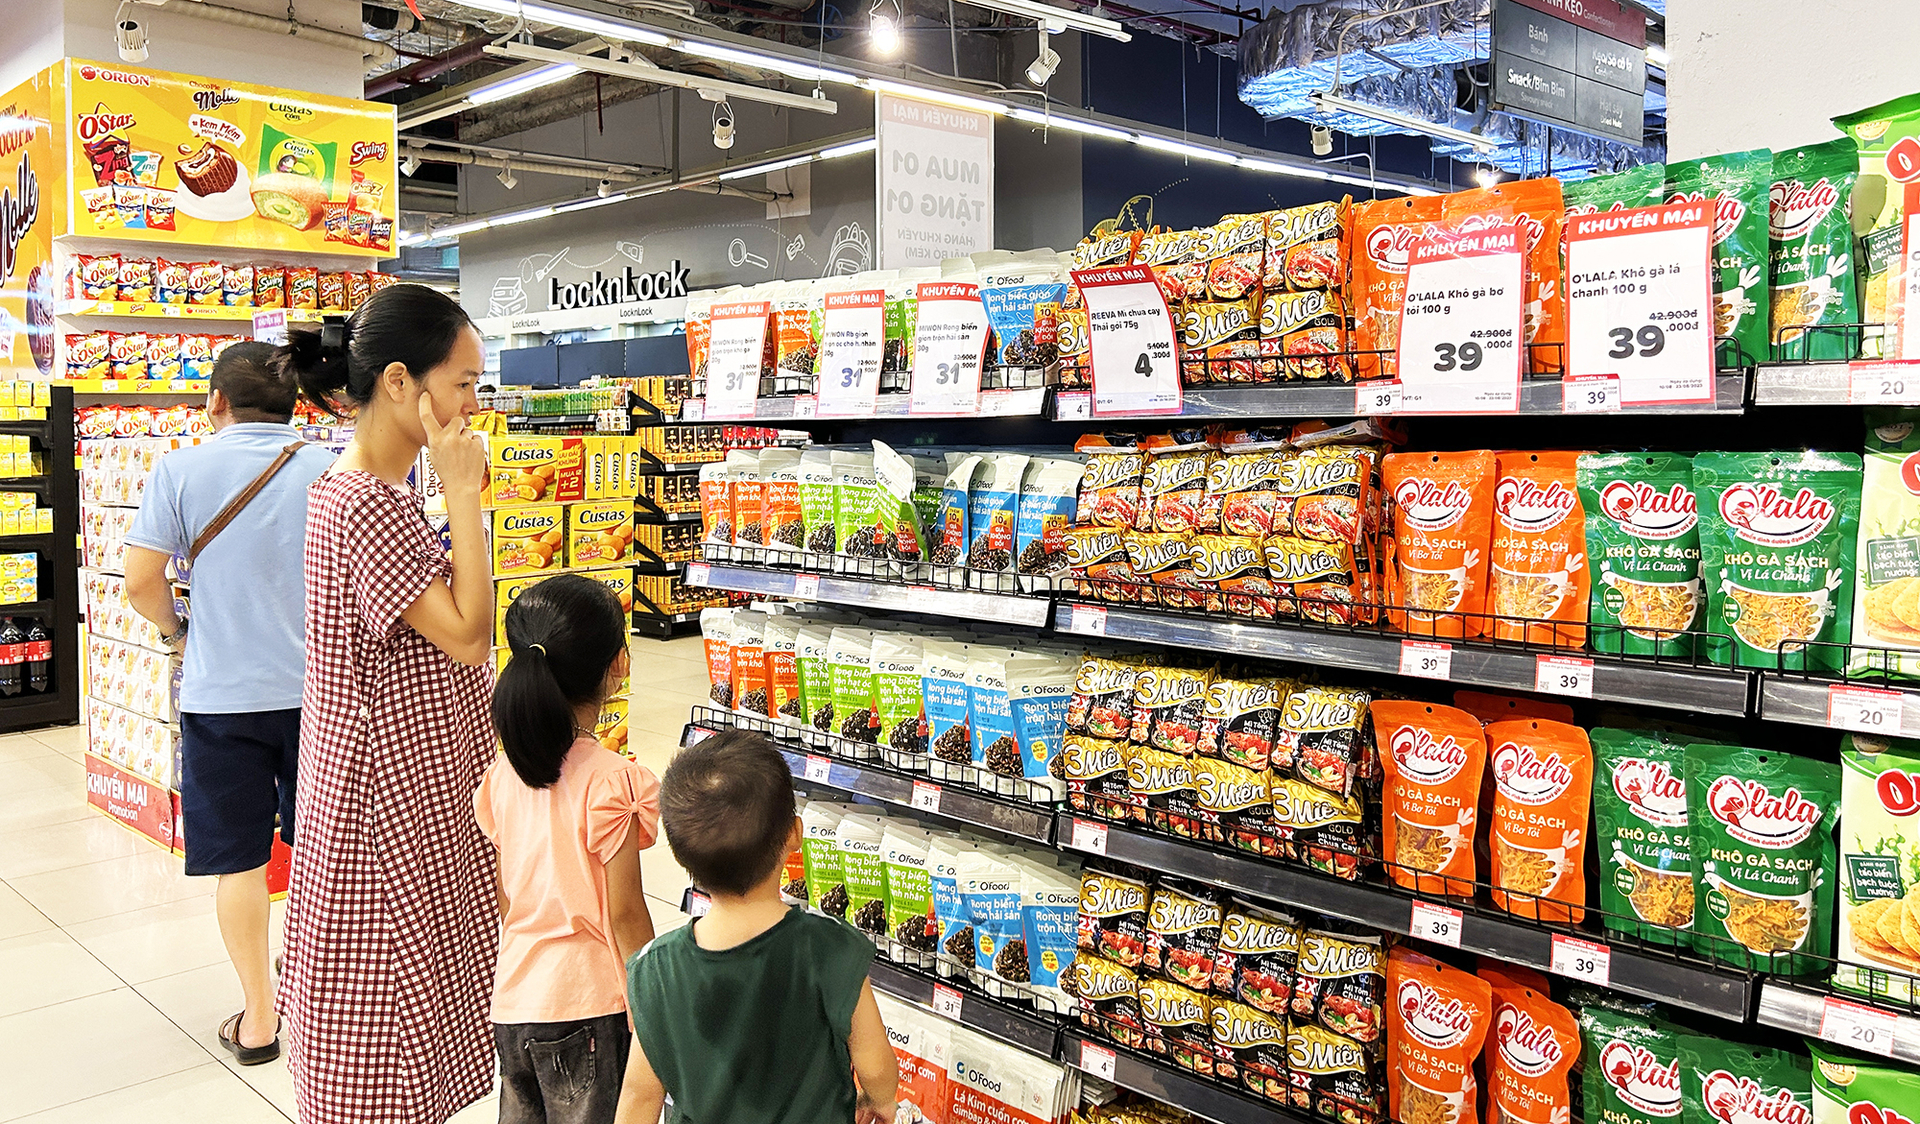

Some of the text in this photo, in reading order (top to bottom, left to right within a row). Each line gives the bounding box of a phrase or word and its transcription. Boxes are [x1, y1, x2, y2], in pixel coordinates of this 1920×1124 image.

[1528, 24, 1548, 43] Bánh
[100, 68, 150, 86] ORION
[1508, 68, 1565, 98] Snack/Bim Bim
[269, 101, 313, 116] Custas
[79, 113, 133, 140] O'Star
[200, 118, 217, 130] Kem
[351, 142, 386, 161] Swing
[94, 151, 128, 180] Zing
[132, 155, 156, 176] Zing
[1267, 212, 1289, 245] 3
[1578, 208, 1702, 234] KHUYẾN MẠI
[1416, 233, 1515, 259] KHUYẾN MẠI
[90, 265, 118, 283] O'Star
[193, 265, 221, 287] O'Star
[1079, 267, 1146, 284] KHUYẾN MẠI
[1572, 263, 1680, 284] O'LALA Khô gà lá
[547, 260, 690, 310] LocknLock
[922, 284, 965, 297] KHUYẾN
[1572, 283, 1648, 299] chanh 100 g
[828, 293, 880, 305] KHUYẾN MẠI
[1408, 286, 1504, 303] O'LALA Khô gà bơ
[620, 307, 653, 318] LocknLock
[714, 304, 763, 316] KHUYẾN MẠI
[1091, 308, 1161, 320] REEVA chua cay
[1422, 304, 1440, 315] 100
[1444, 305, 1451, 316] g
[1649, 309, 1698, 322] 42.900đ
[512, 319, 540, 328] LocknLock
[1125, 319, 1139, 330] 75g
[1260, 301, 1277, 336] 3
[919, 322, 978, 332] MIWON Rong biển
[1470, 328, 1512, 338] 42.900đ
[1666, 321, 1699, 333] .000đ
[115, 341, 145, 358] O'Star
[1483, 340, 1513, 349] .000đ
[1608, 325, 1666, 360] 39
[1134, 353, 1153, 377] 4
[1434, 342, 1483, 372] 39
[726, 372, 744, 391] 31
[841, 368, 862, 388] 31
[936, 363, 960, 385] 31
[1880, 381, 1904, 396] 20
[1376, 394, 1391, 407] 39
[1587, 391, 1606, 405] 39
[1077, 405, 1082, 414] 4
[501, 446, 554, 461] Custas
[594, 453, 603, 491] Custas
[612, 452, 621, 490] Custas
[630, 452, 639, 489] Custas
[1281, 459, 1356, 492] 3 Miền
[560, 477, 579, 490] +2
[504, 514, 554, 530] Custas
[579, 509, 625, 525] Custas
[1413, 538, 1467, 550] GÀ SẠCH
[1418, 550, 1429, 559] Bơ
[1605, 545, 1699, 561] KHÔ GÀ SẠCH
[1724, 552, 1829, 569] KHÔ GÀ SẠCH
[1265, 546, 1340, 580] 3 Miền
[1623, 560, 1687, 572] Vị Lá Chanh
[695, 572, 704, 583] 31
[1740, 568, 1811, 582] Vị Lá Chanh
[804, 586, 813, 596] 31
[1091, 619, 1098, 629] 4
[1421, 658, 1437, 670] 39
[1560, 675, 1578, 688] 39
[1206, 683, 1278, 715] 3 Miền
[1286, 694, 1304, 727] 3
[1859, 709, 1883, 725] 20
[815, 768, 823, 778] 31
[87, 772, 147, 811] KHUYẾN MẠI
[1407, 788, 1461, 808] GÀ SẠCH
[924, 795, 933, 806] 31
[1402, 801, 1423, 814] Vị Bơ
[108, 801, 138, 820] Promotion
[1508, 808, 1566, 831] GÀ SẠCH
[1328, 823, 1353, 835] GOLD
[1504, 821, 1525, 835] Vị Bơ
[1092, 839, 1099, 848] 4
[1711, 848, 1813, 874] KHÔ GÀ SẠCH
[1730, 866, 1799, 885] Vị Lá Chanh
[1431, 921, 1448, 936] 39
[1300, 937, 1379, 974] 3 Miền
[1575, 958, 1594, 973] 39
[944, 1002, 954, 1012] 31
[1851, 1026, 1875, 1043] 20
[1287, 1035, 1364, 1068] 3 Miền
[1101, 1063, 1107, 1073] 4
[969, 1069, 1001, 1093] O'food
[954, 1088, 986, 1112] Lá Kim
